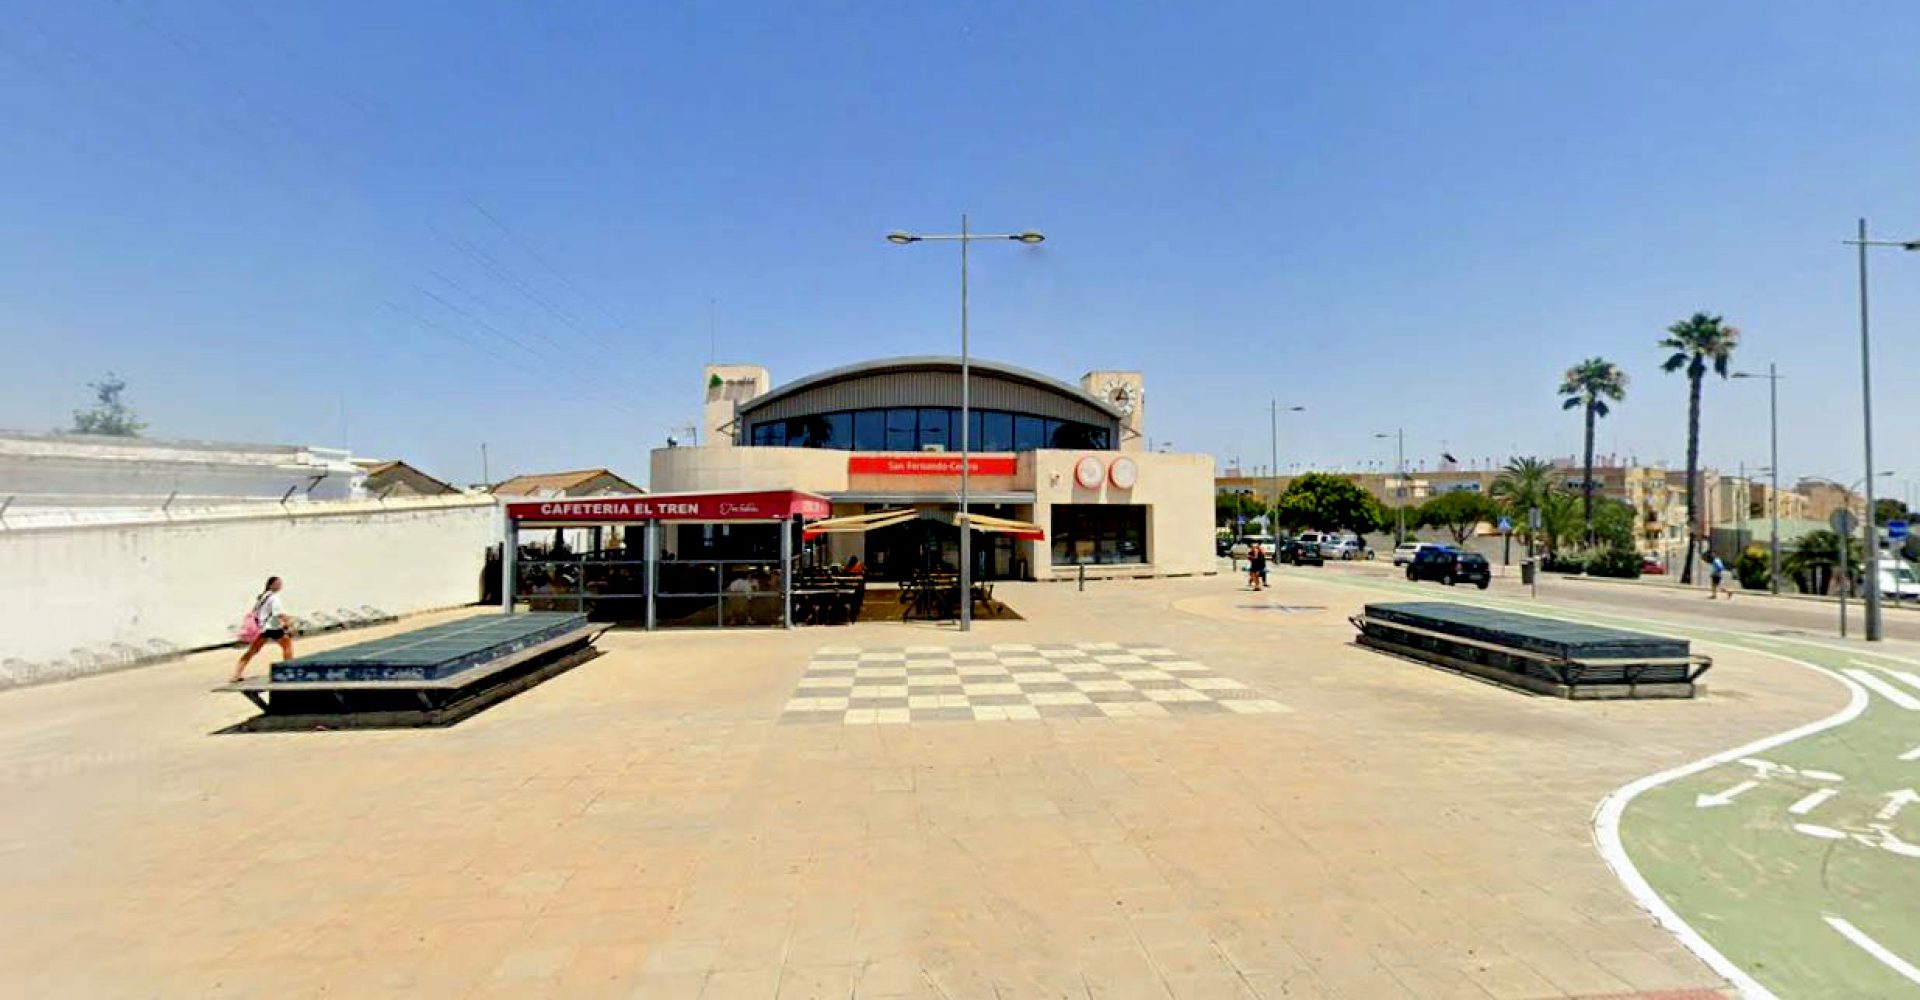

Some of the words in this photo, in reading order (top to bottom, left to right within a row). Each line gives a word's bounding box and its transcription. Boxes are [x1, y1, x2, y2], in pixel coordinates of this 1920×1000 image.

[888, 461, 904, 471] San
[906, 461, 979, 472] Fernando-Cenro
[541, 503, 629, 515] CAFETERIA
[634, 504, 653, 514] EL
[657, 503, 699, 514] TREN
